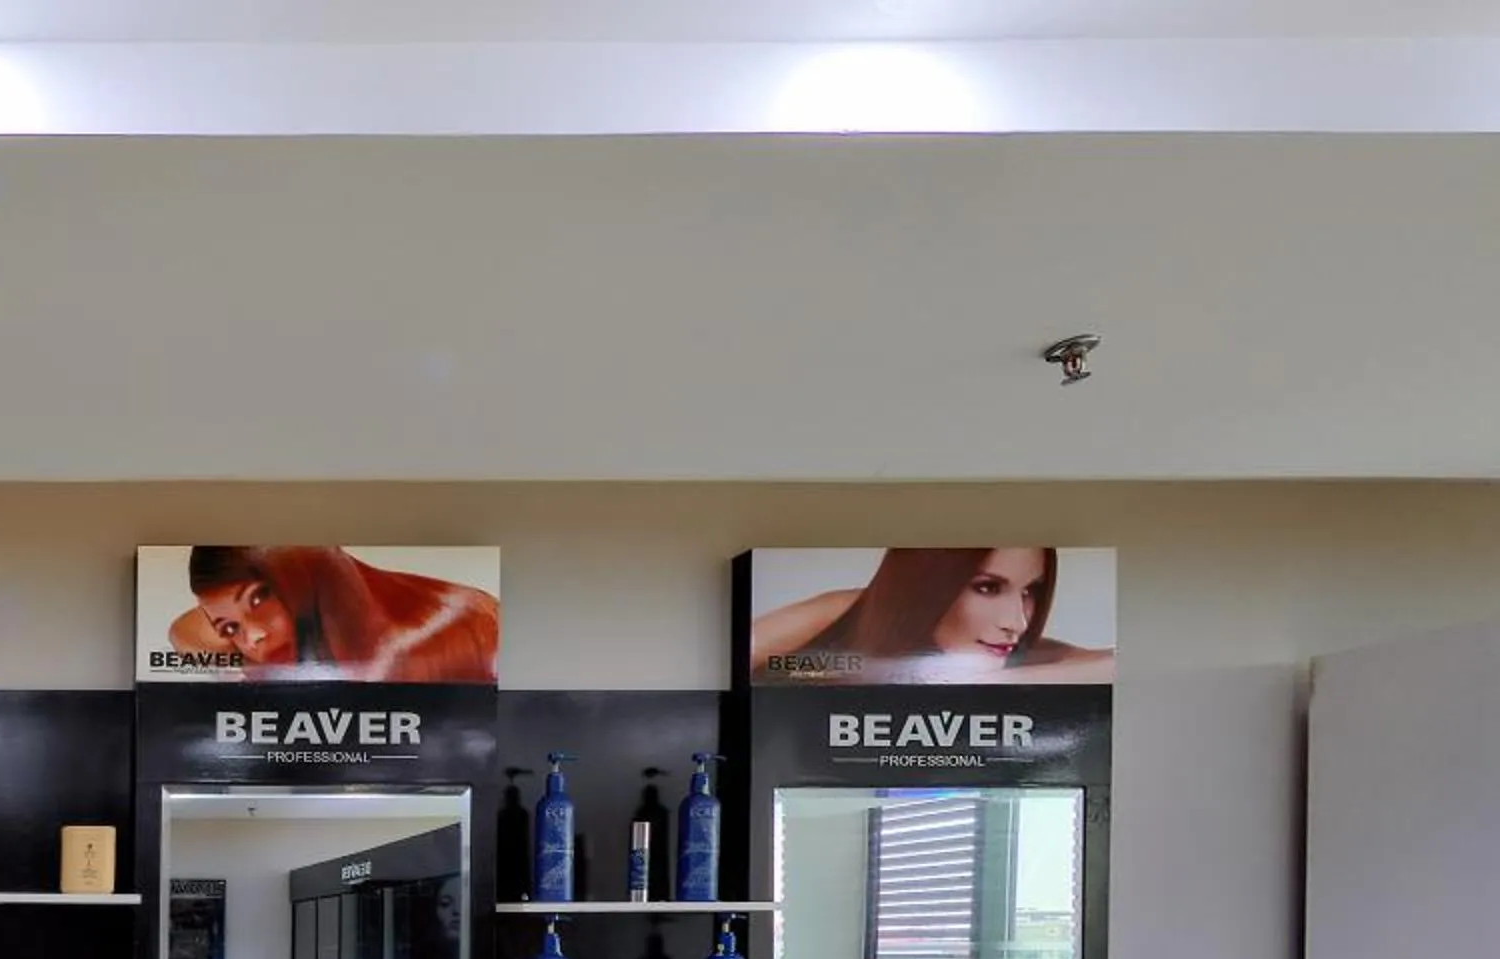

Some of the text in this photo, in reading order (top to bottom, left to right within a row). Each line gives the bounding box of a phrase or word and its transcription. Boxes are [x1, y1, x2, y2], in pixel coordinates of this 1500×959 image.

[150, 650, 244, 667] BEAVER
[767, 654, 863, 671] BEAVER
[215, 708, 421, 745] BEAVER
[828, 711, 1034, 747] BEAVER
[266, 751, 371, 764] PROFESSIONAL
[879, 755, 985, 767] PROFESSIONAL
